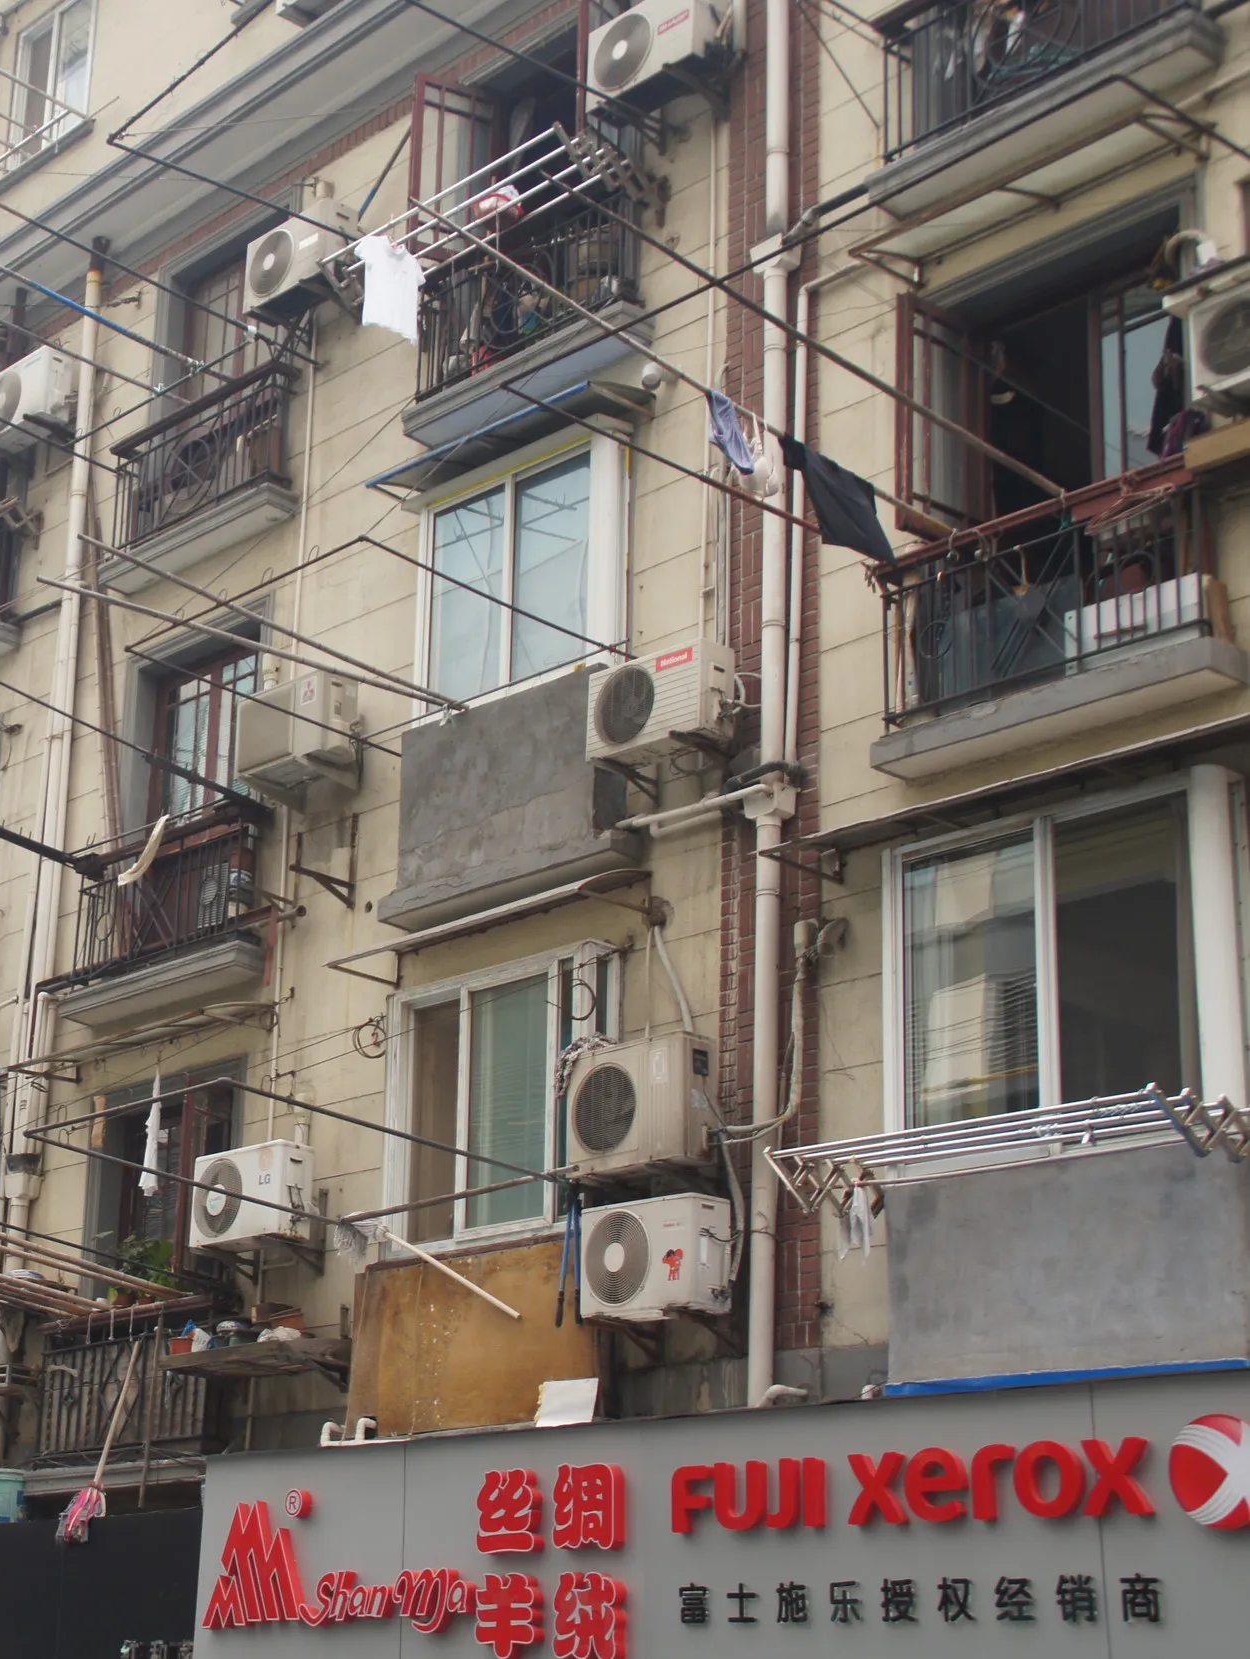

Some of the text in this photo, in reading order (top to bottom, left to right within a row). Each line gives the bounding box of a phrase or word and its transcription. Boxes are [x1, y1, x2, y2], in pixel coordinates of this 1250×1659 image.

[258, 1173, 271, 1185] LG
[476, 1463, 627, 1554] 丝绸
[670, 1456, 827, 1534] FUJI
[475, 1571, 629, 1659] 羊绒
[678, 1572, 1164, 1626] 富士施乐授权经销商
